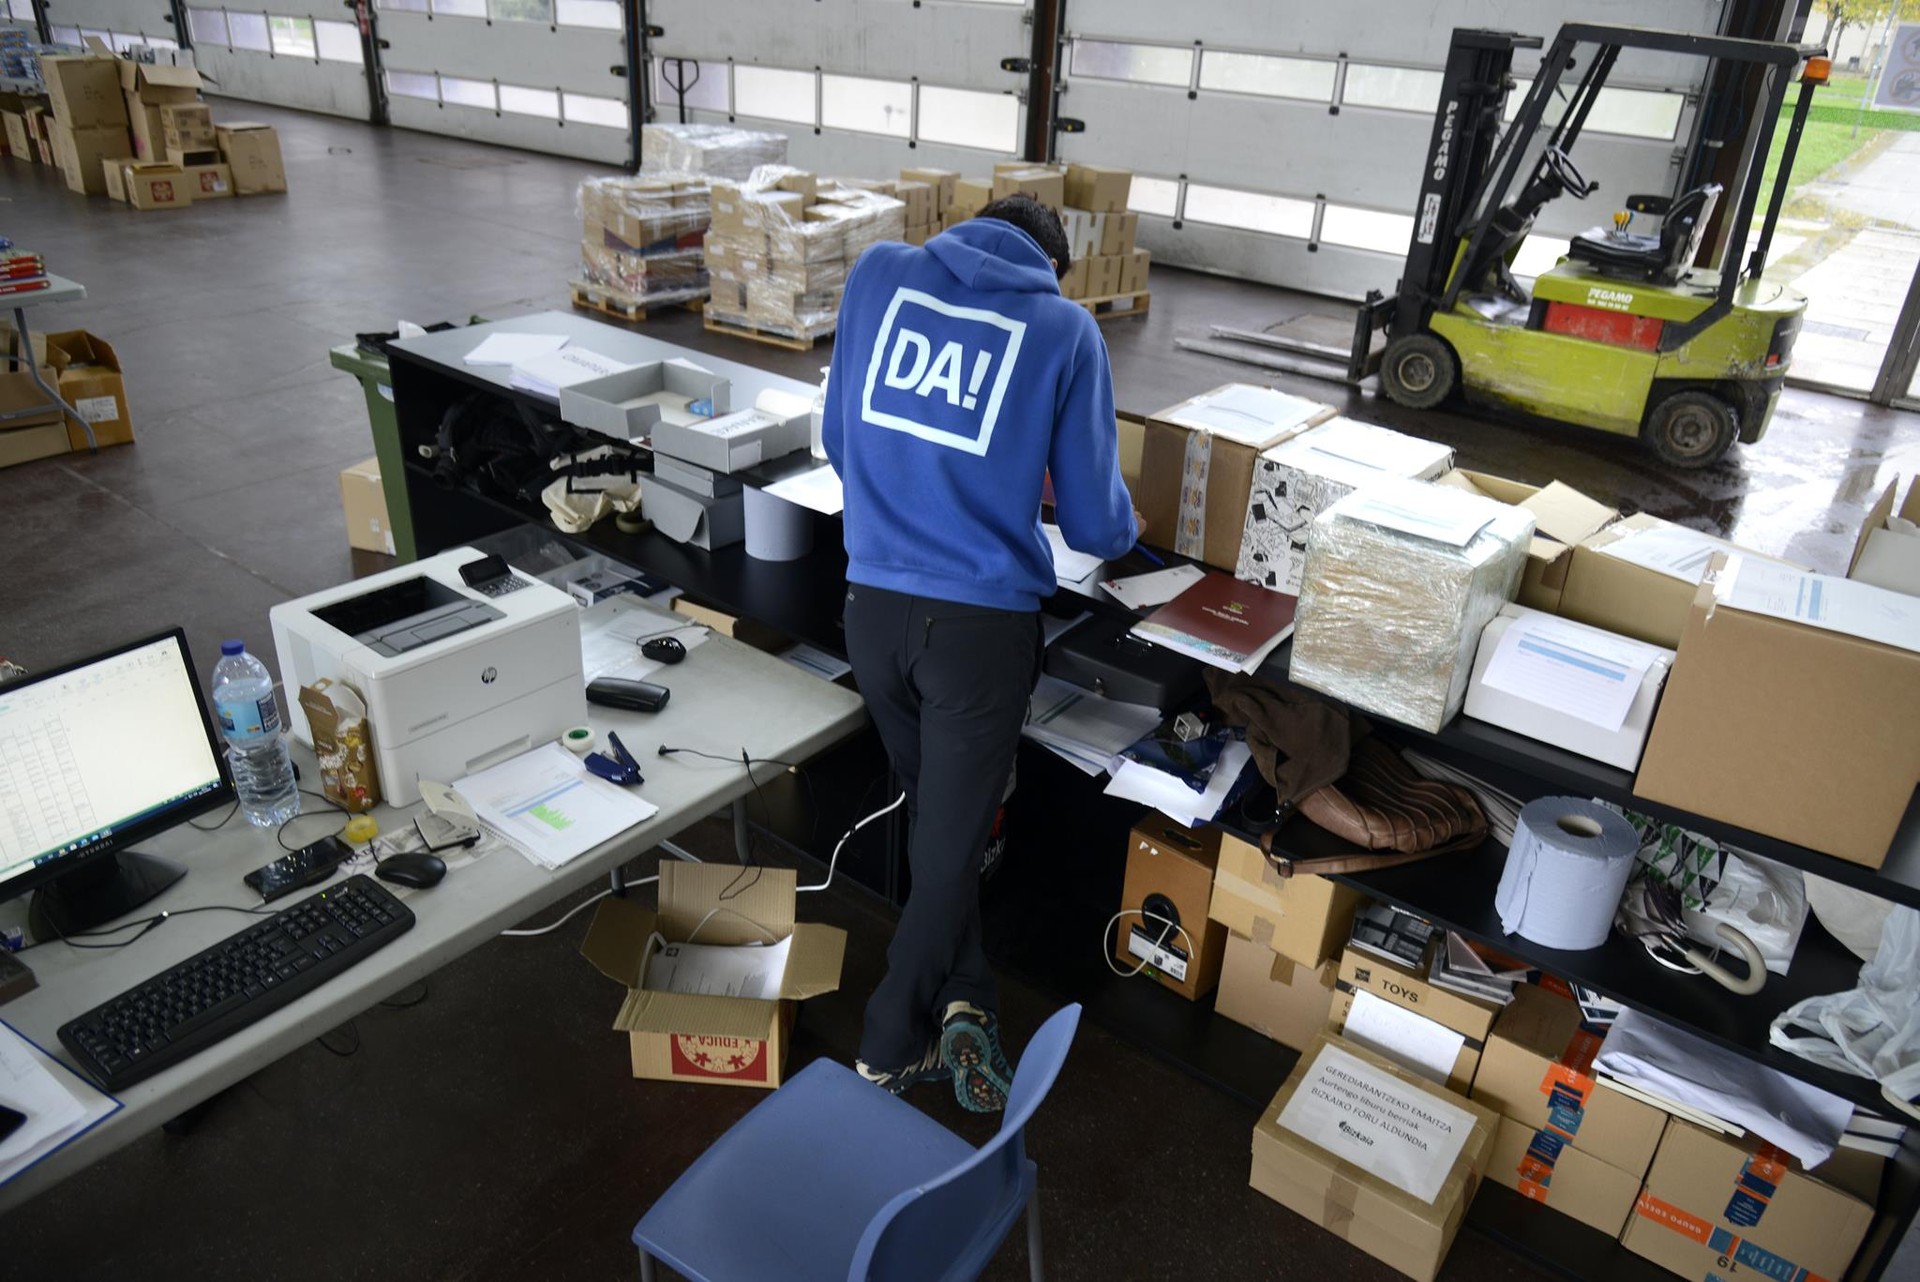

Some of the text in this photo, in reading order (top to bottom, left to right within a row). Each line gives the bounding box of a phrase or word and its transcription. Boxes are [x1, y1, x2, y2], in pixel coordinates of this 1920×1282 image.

[1434, 101, 1458, 180] PEGAMO
[1588, 287, 1633, 304] PEGAMO
[884, 327, 992, 411] DA!
[1382, 979, 1419, 1003] TOYS
[698, 1035, 739, 1048] EDUCA
[1311, 1087, 1428, 1151] BIZKAIKO FORU ALDUNDIA
[1318, 1075, 1420, 1131] Aurtengo liburu berriak
[1325, 1065, 1452, 1133] GEREDIARANTZEKO EMAITZA
[1343, 1125, 1374, 1147] Bizkaia
[1670, 1215, 1702, 1234] GRUPO
